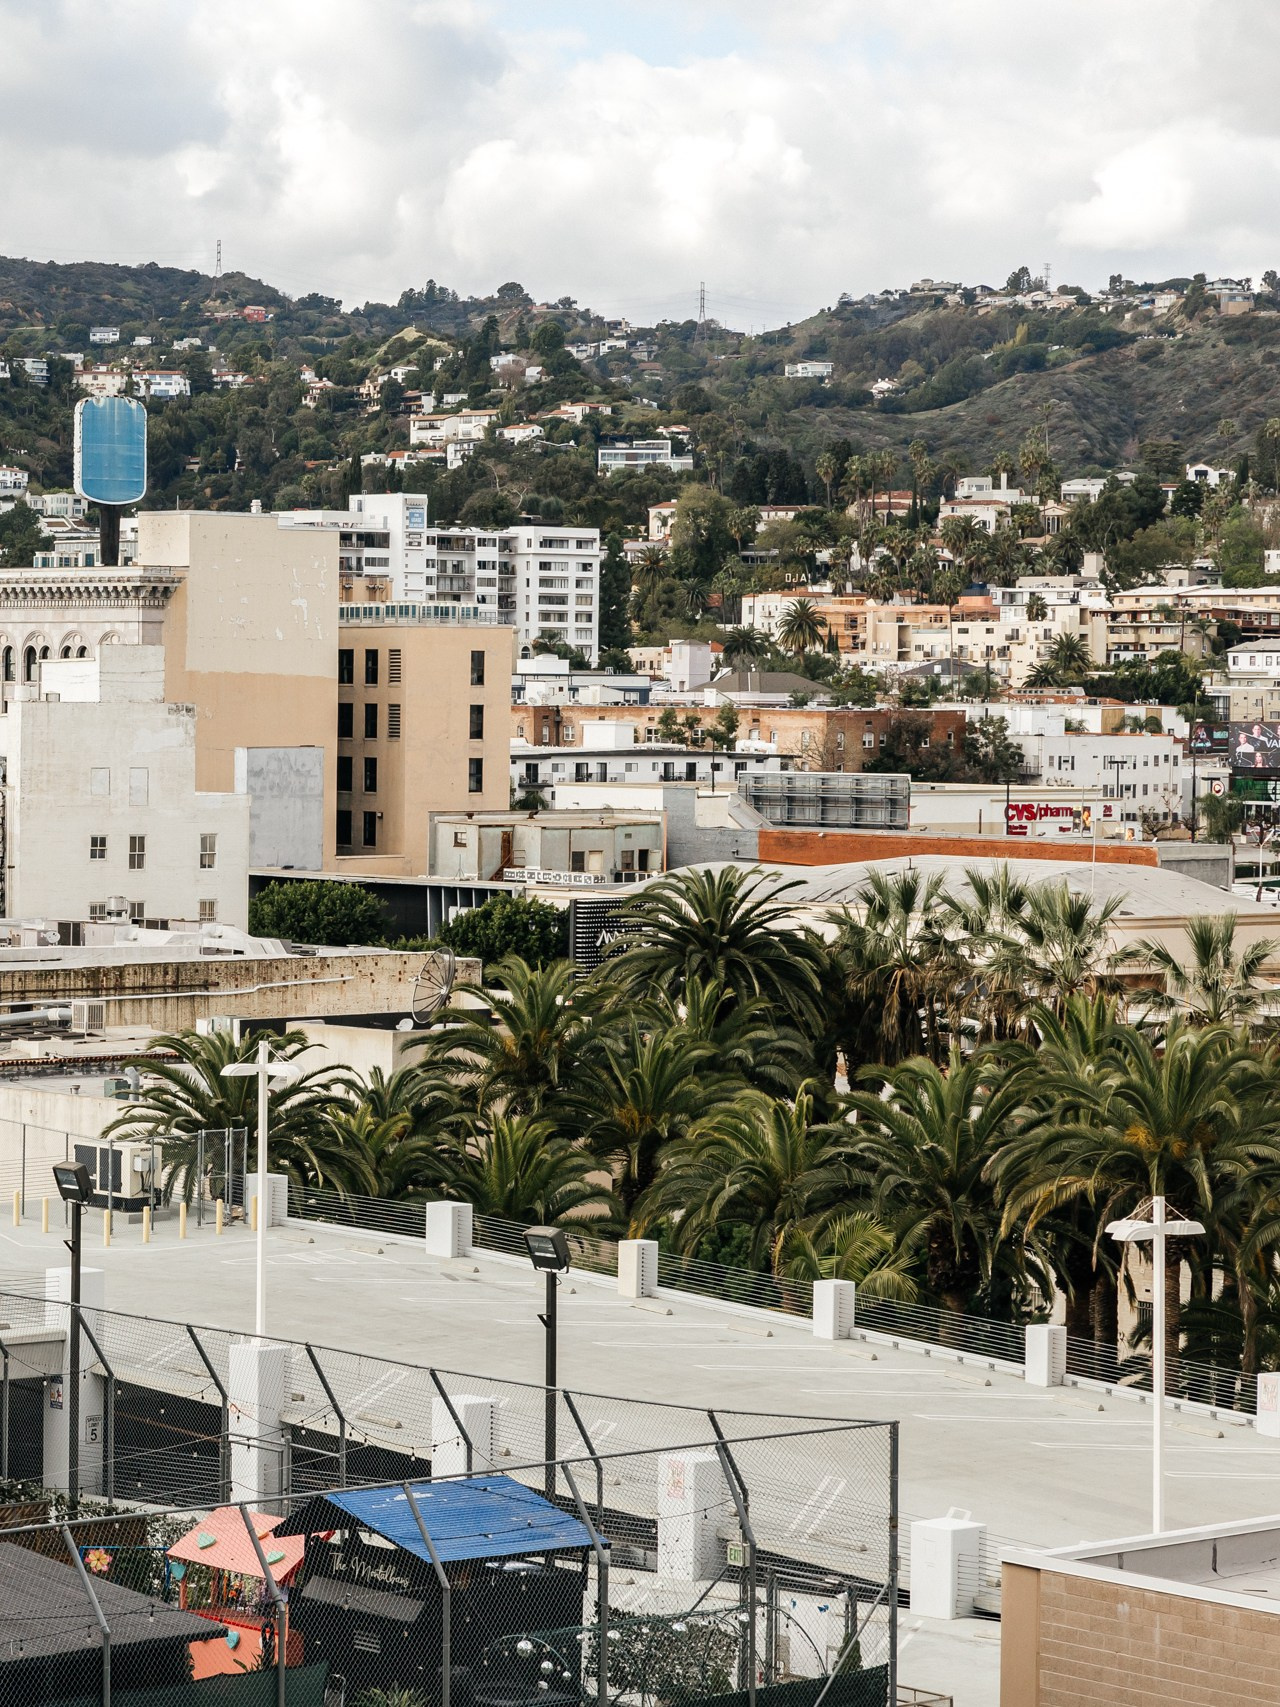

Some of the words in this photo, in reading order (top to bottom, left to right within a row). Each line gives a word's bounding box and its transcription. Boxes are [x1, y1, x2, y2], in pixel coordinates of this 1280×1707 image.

[90, 1428, 98, 1441] 5
[729, 1548, 742, 1562] EXIT
[329, 1552, 348, 1574] The
